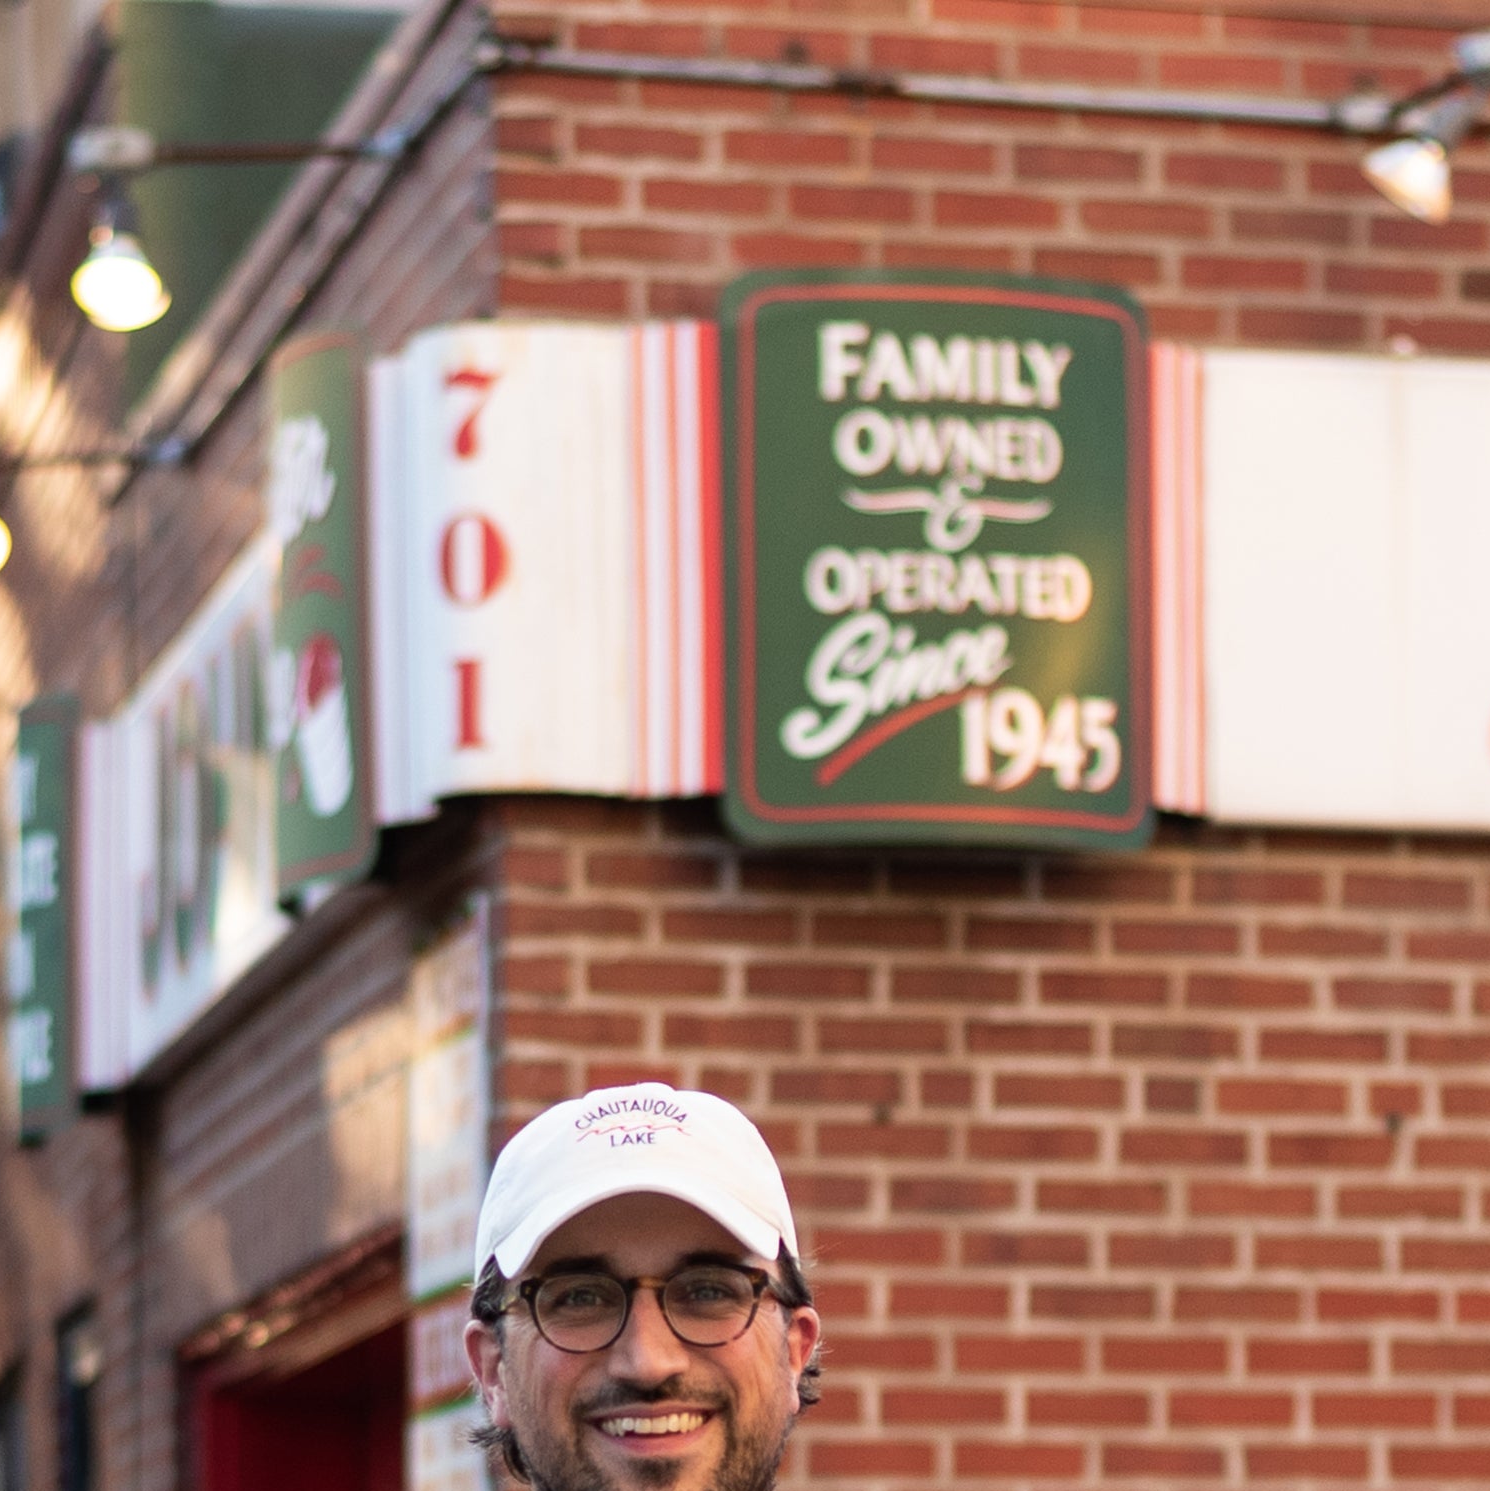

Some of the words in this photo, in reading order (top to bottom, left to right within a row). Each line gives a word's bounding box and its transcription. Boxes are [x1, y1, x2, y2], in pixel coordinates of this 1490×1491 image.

[817, 320, 1073, 408] FAMILY
[832, 406, 1064, 484] OWNED
[804, 546, 1092, 622] OPERATED
[780, 612, 1010, 759] Since
[960, 687, 1121, 793] 1945
[575, 1099, 688, 1130] CHAUTAUQUA
[610, 1132, 656, 1147] LAKE
